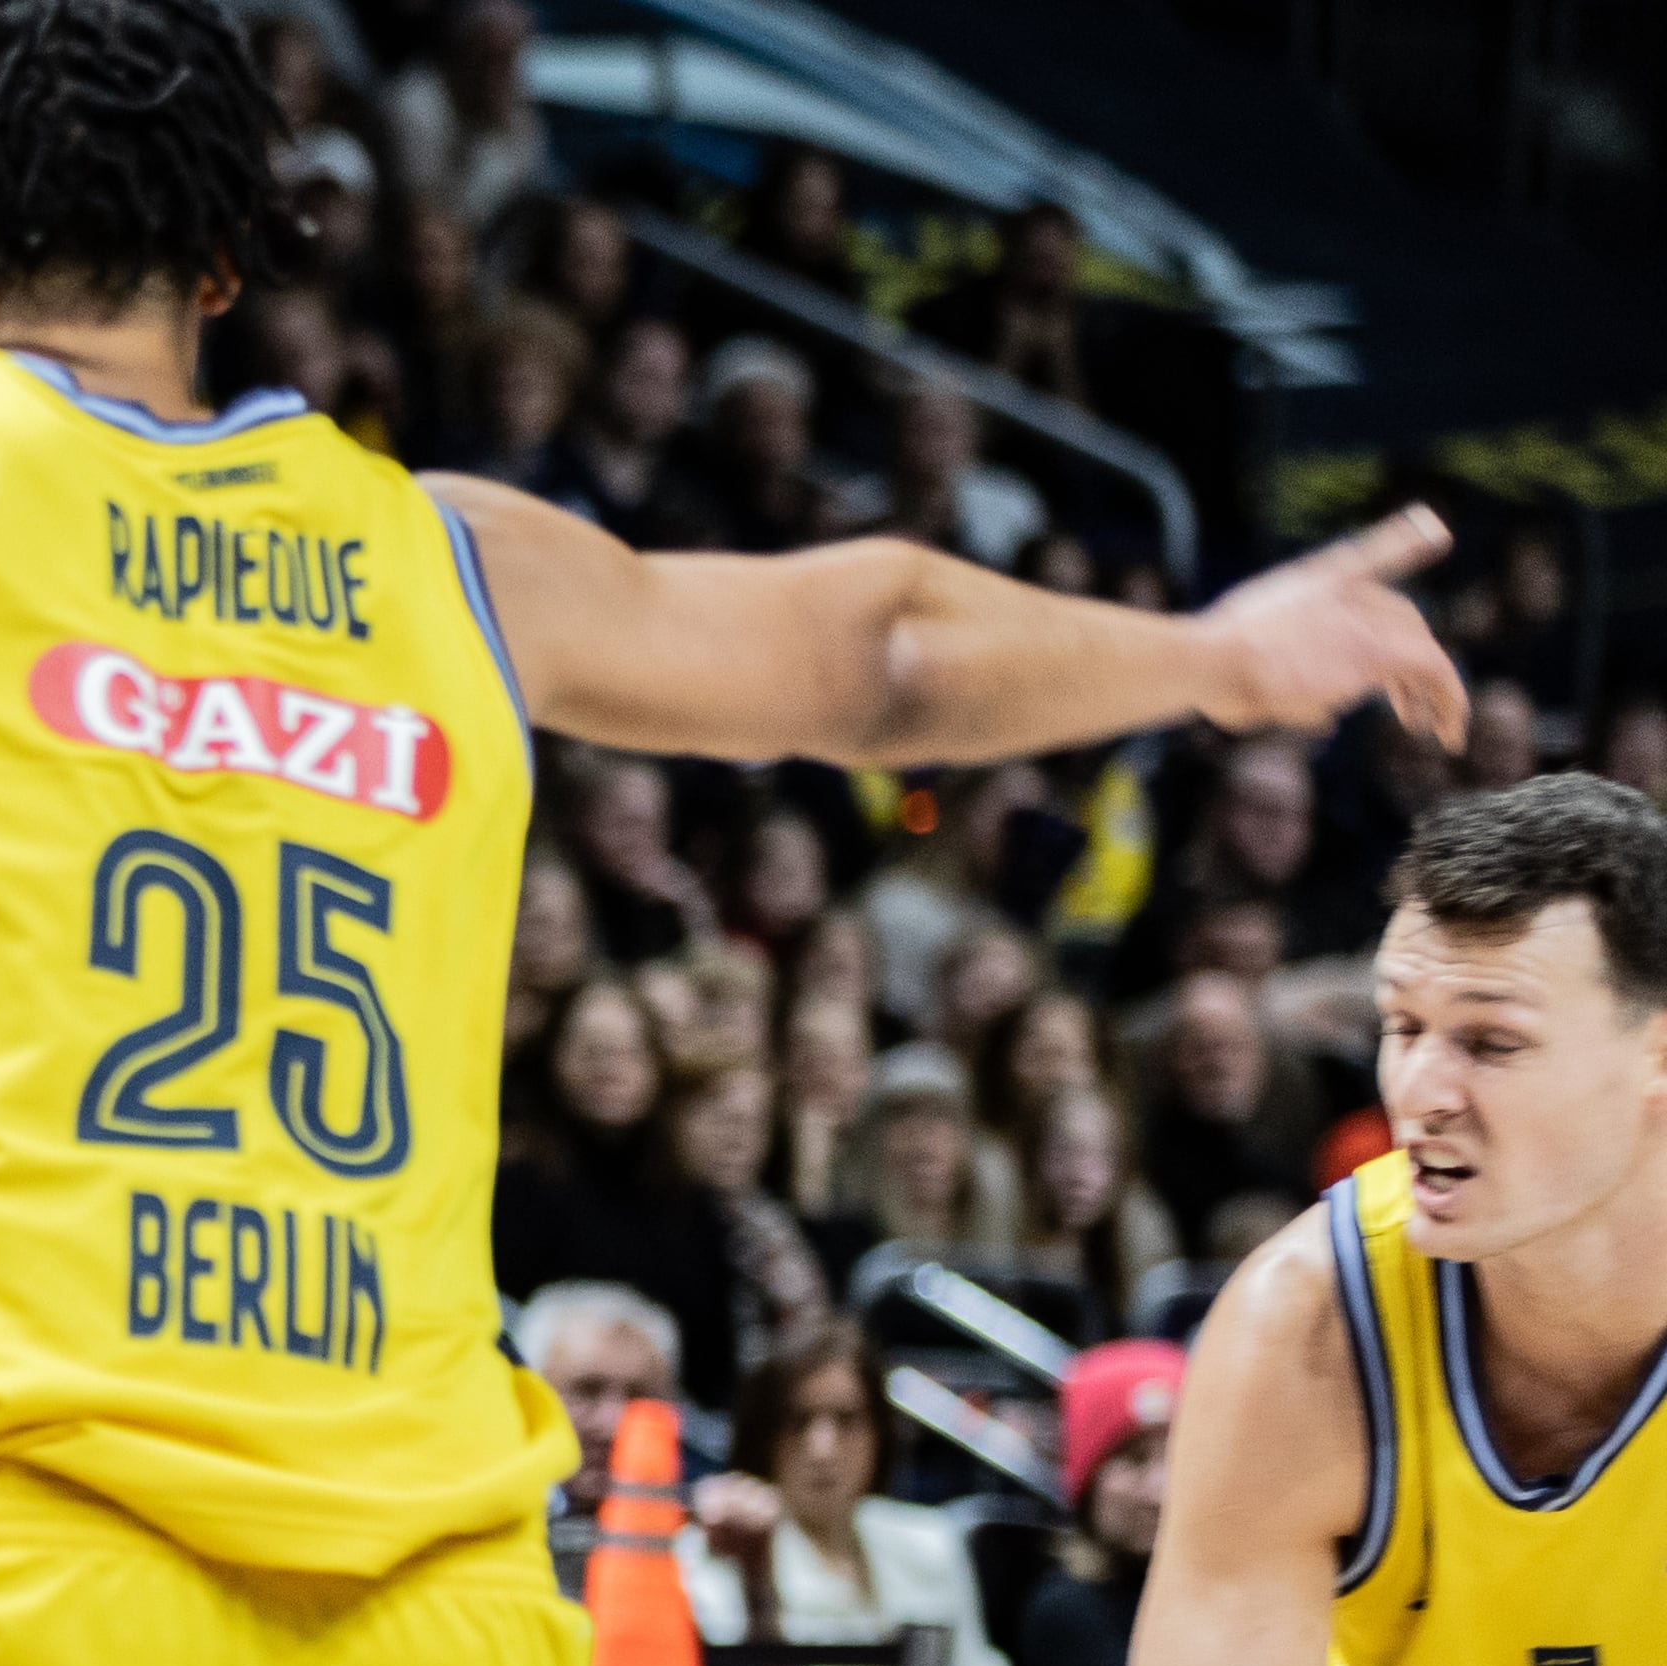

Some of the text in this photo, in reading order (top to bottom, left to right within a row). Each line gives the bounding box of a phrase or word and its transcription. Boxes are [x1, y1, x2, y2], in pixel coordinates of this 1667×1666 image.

[106, 498, 371, 641] RAPIEQUE
[76, 827, 413, 1180] 25
[127, 1191, 387, 1377] BERLIN
